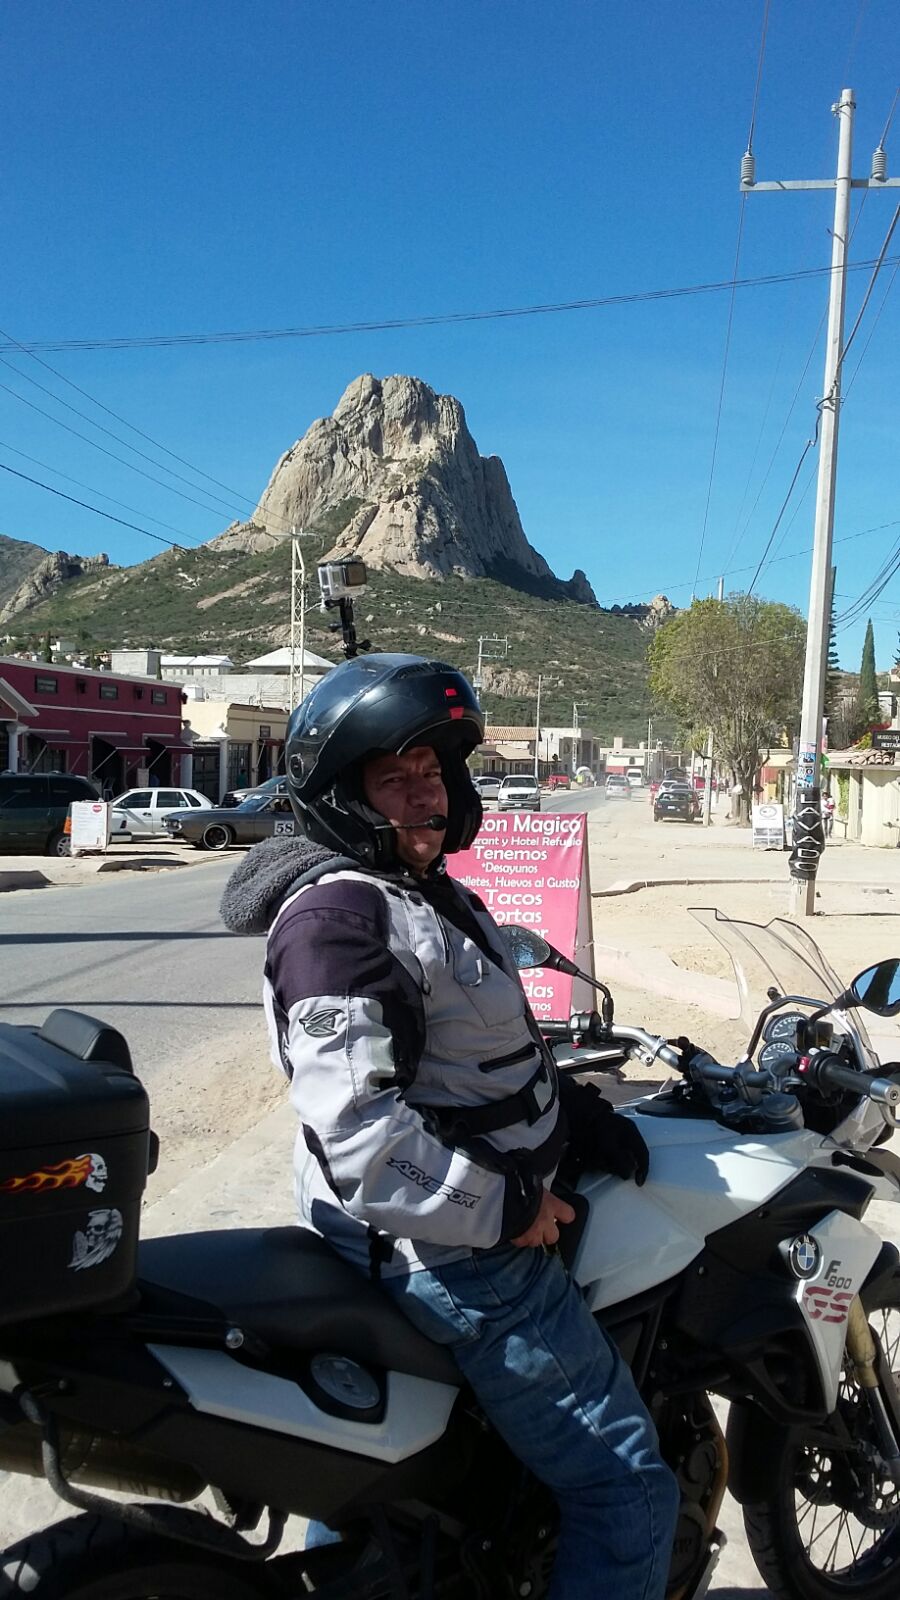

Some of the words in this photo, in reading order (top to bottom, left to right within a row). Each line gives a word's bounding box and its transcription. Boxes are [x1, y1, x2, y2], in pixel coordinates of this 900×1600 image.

[276, 823, 293, 833] 58
[513, 814, 581, 836] Magico
[794, 793, 822, 871] LAVADO
[502, 838, 508, 847] y
[511, 837, 540, 846] Hotel
[474, 845, 548, 861] Tenemos
[495, 876, 532, 887] Huevos
[535, 876, 545, 887] al
[547, 876, 580, 890] Gusto)
[485, 888, 543, 906] Tacos
[824, 1260, 841, 1280] F
[827, 1275, 852, 1289] 800
[803, 1286, 854, 1324] GS
